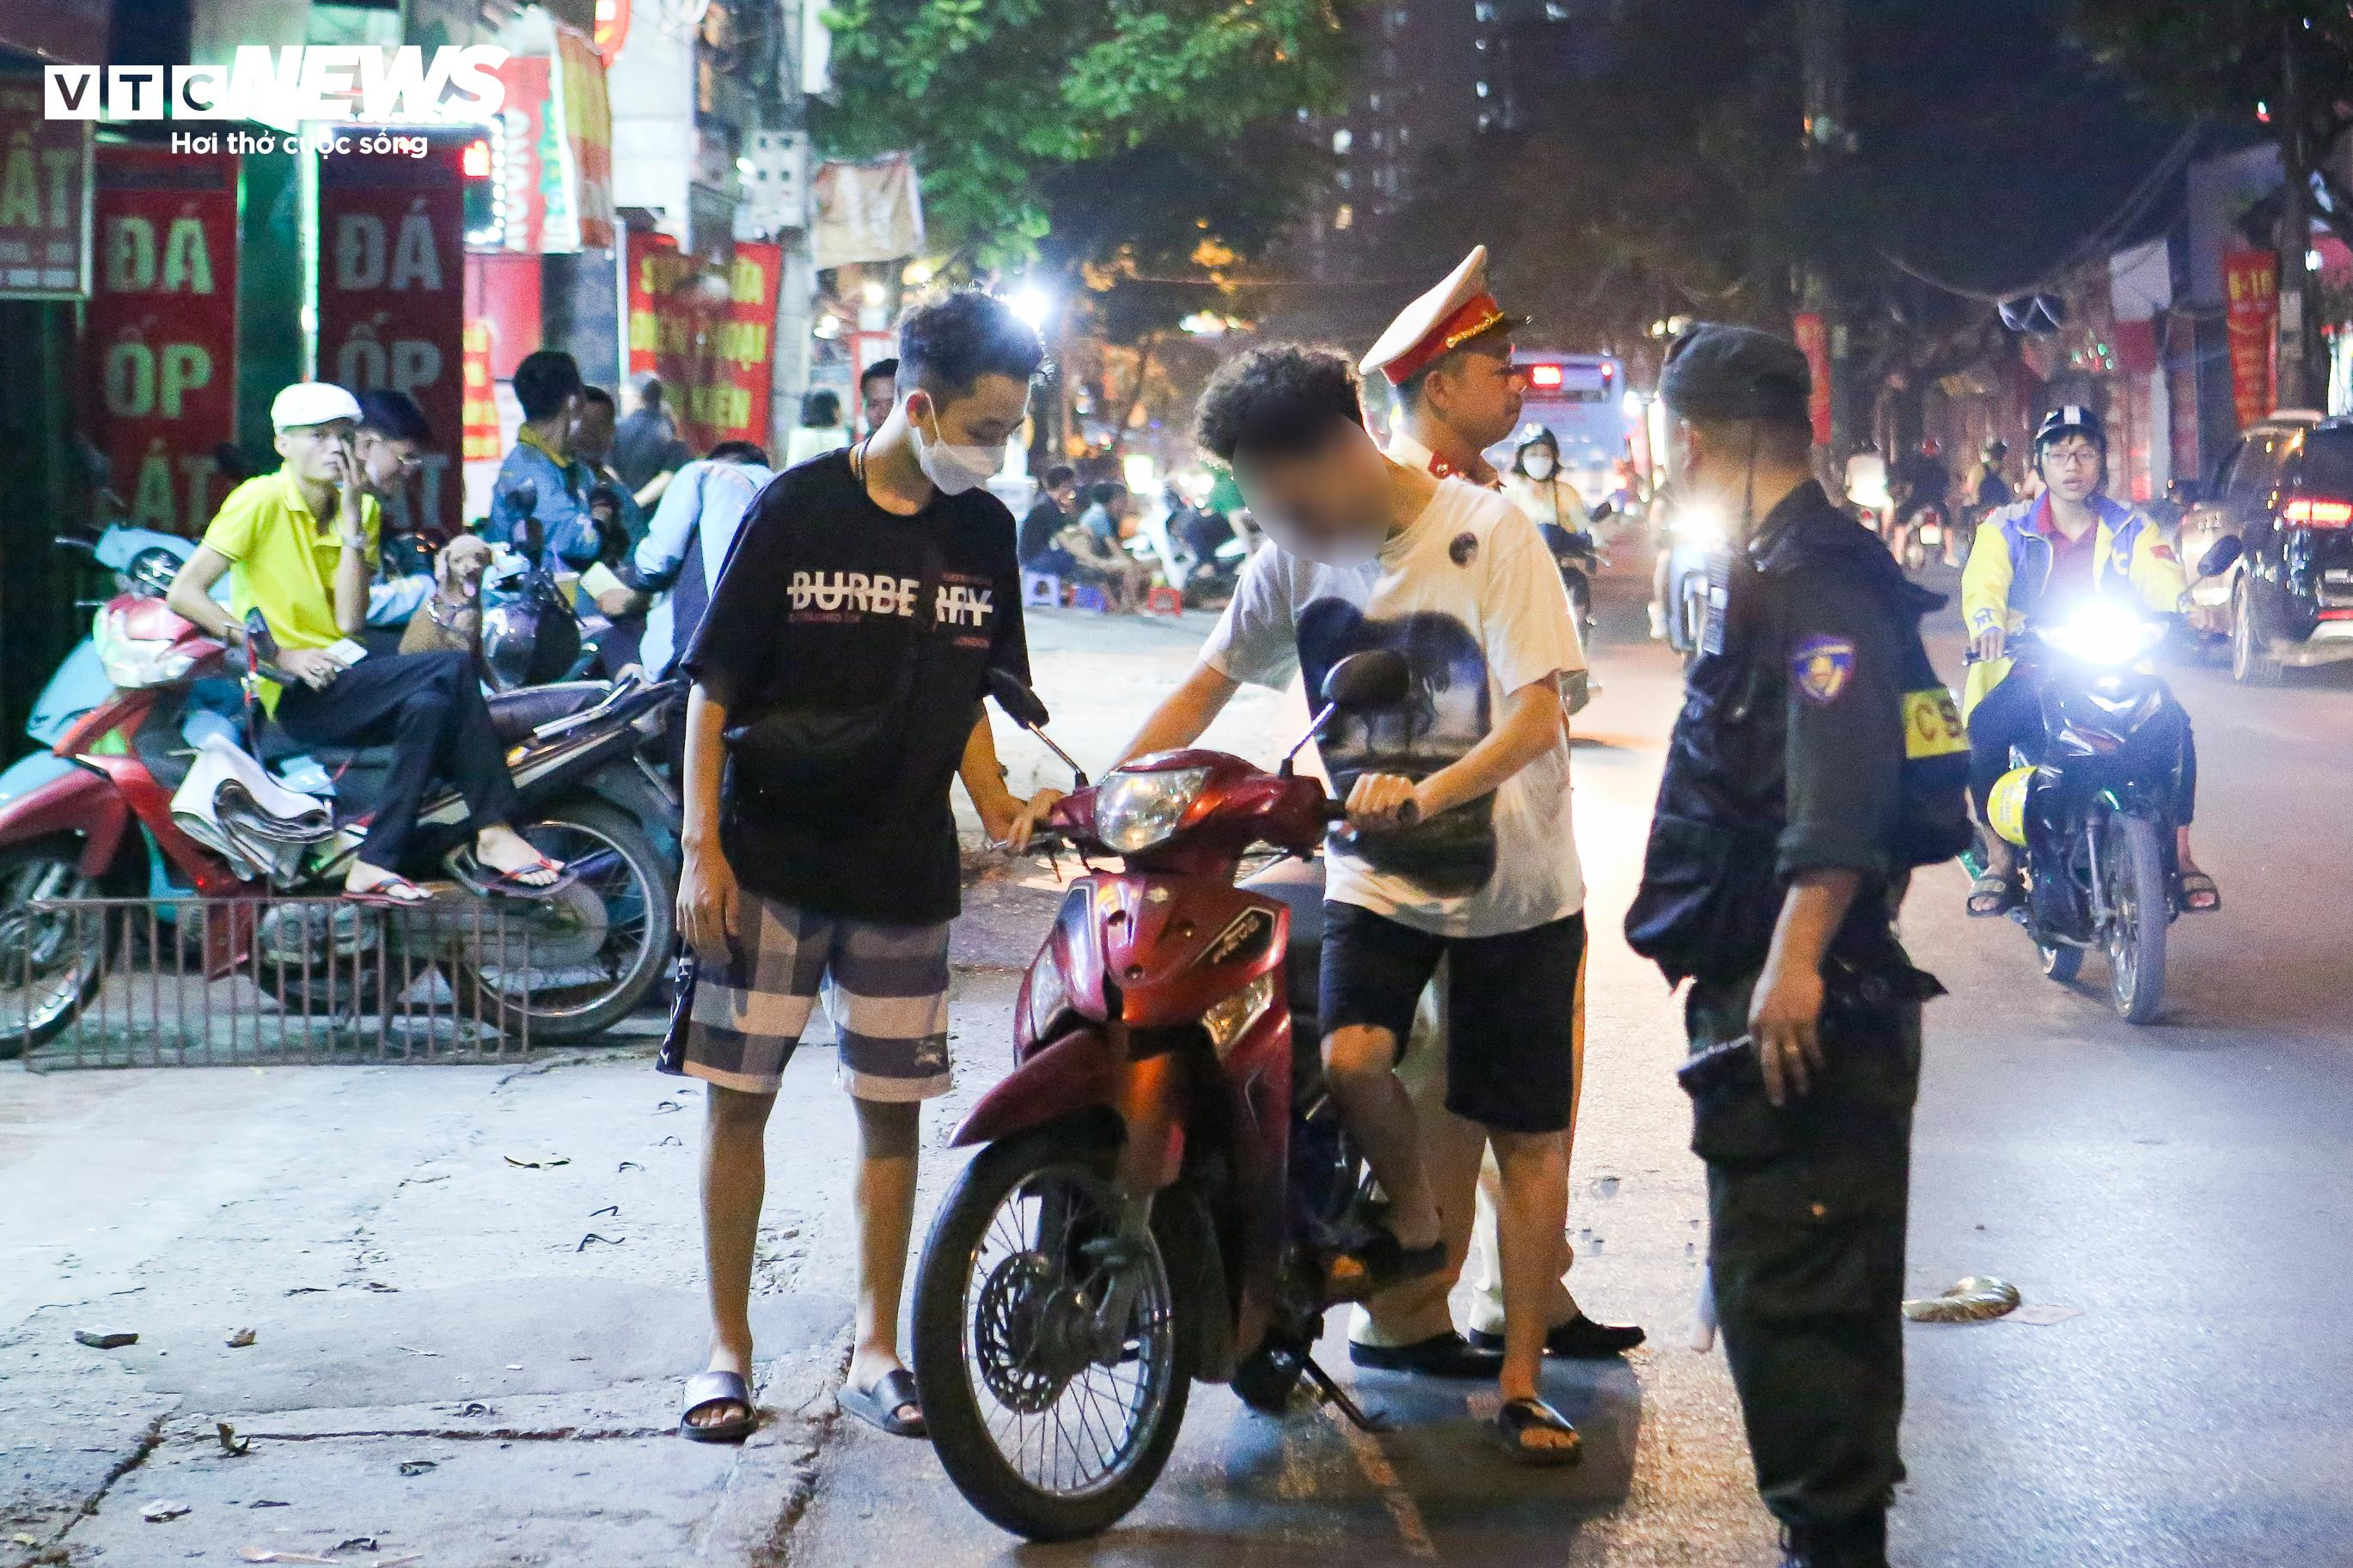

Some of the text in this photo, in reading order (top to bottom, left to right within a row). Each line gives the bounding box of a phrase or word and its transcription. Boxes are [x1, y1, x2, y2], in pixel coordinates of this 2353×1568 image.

[106, 202, 215, 295] ĐÁ
[335, 198, 444, 293] ĐÁ
[105, 314, 214, 419] ỐP
[787, 571, 920, 617] BURBE
